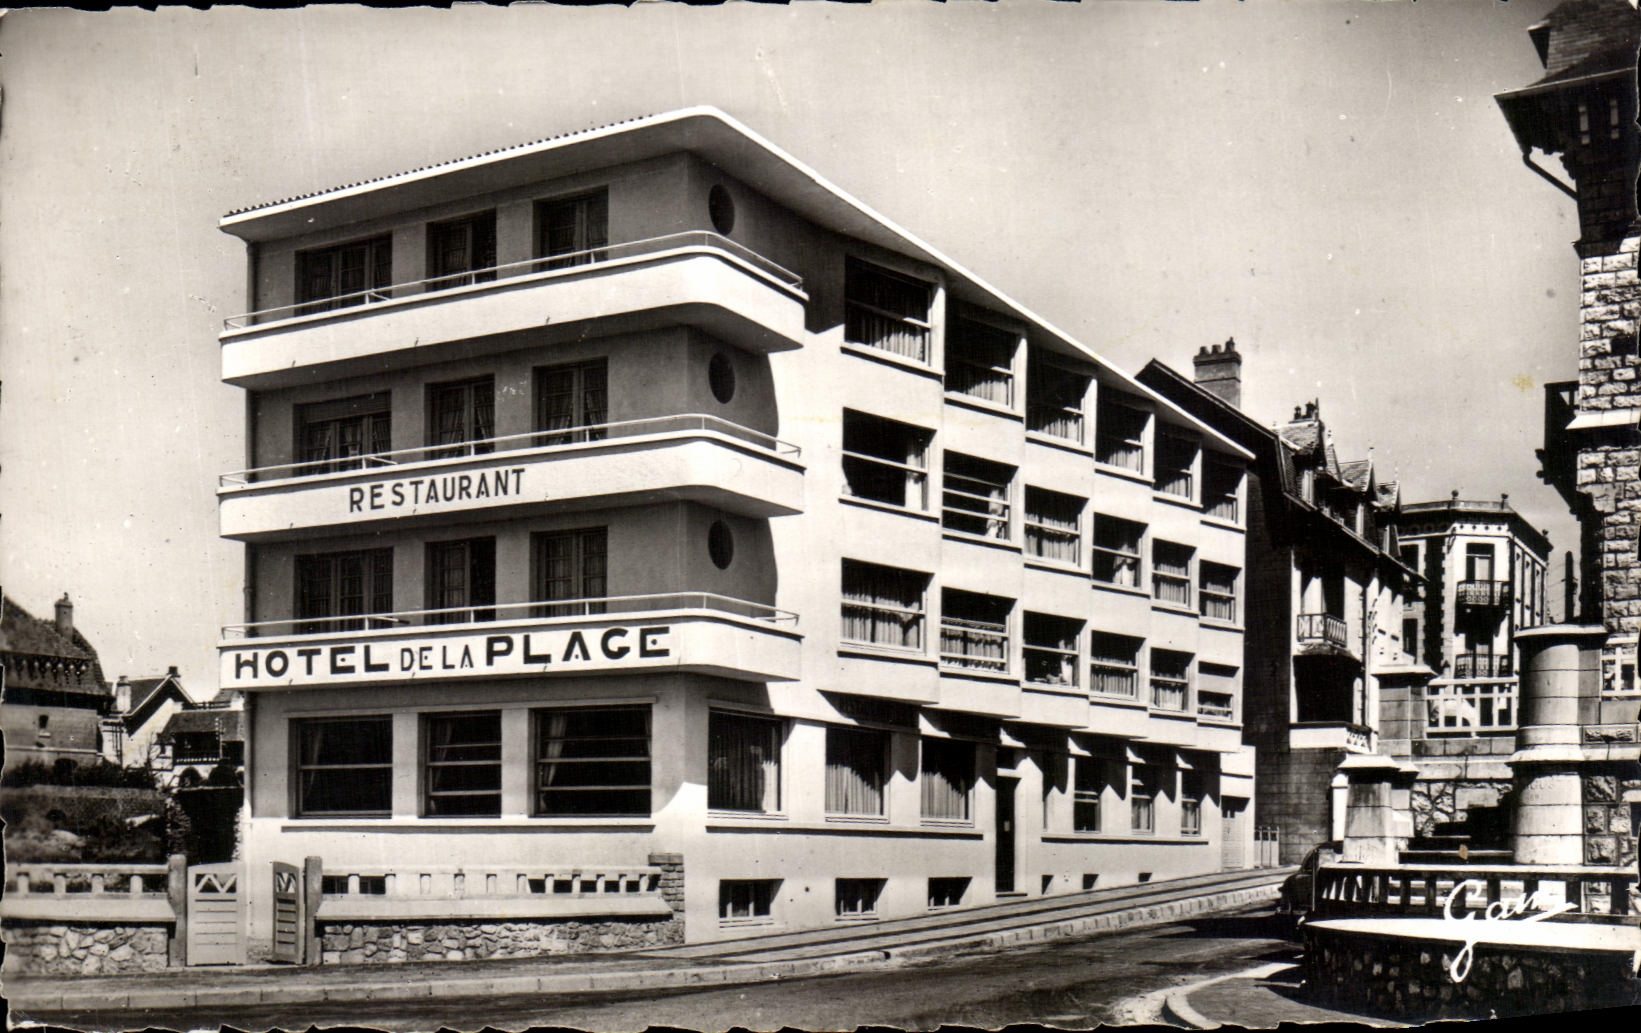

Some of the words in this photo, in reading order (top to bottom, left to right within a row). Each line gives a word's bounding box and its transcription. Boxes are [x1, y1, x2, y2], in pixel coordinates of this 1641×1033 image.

[349, 467, 526, 513] RESTAURANT
[235, 645, 390, 679] HOTEL
[400, 646, 433, 672] DE
[442, 644, 474, 670] LA
[485, 626, 670, 666] PLAGE
